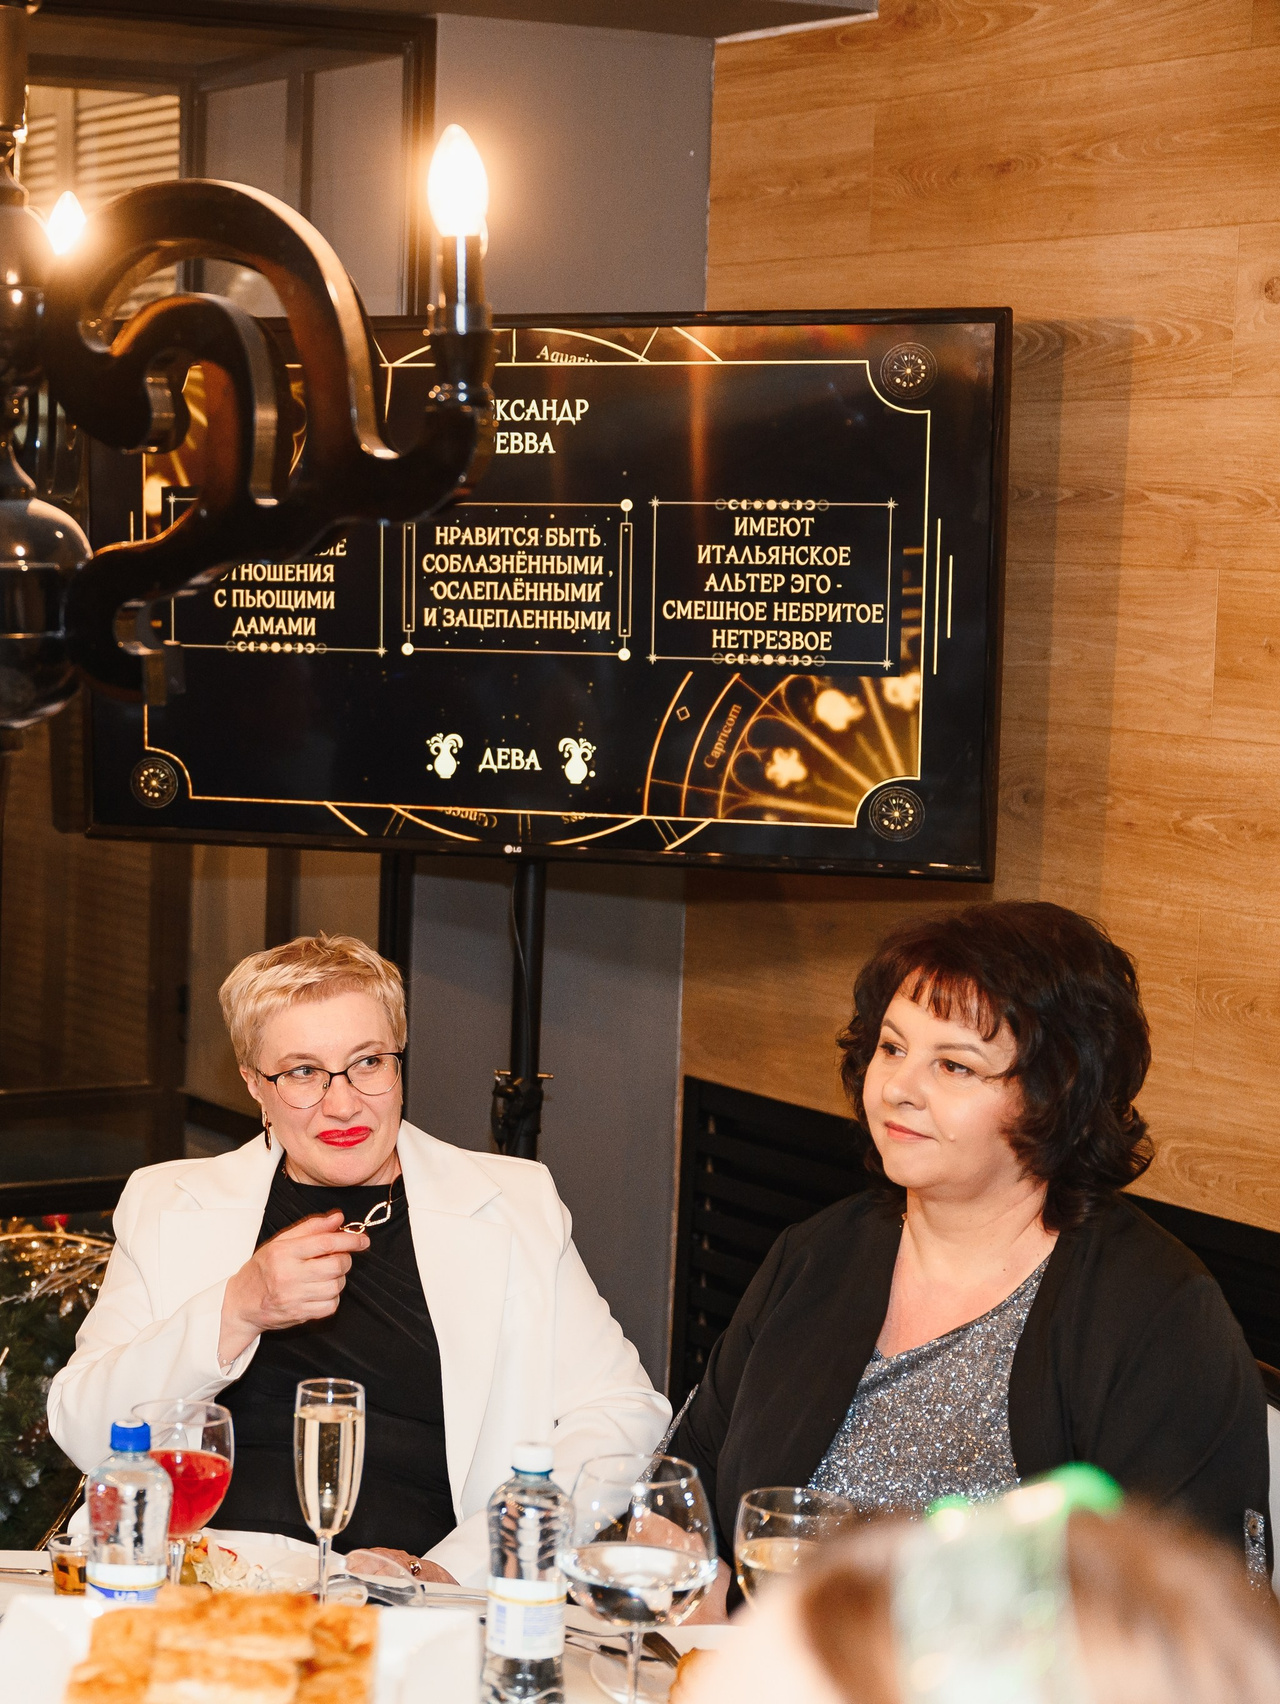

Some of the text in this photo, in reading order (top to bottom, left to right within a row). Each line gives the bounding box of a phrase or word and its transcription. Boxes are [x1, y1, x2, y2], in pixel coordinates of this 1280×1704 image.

[536, 345, 598, 363] Aquari
[491, 399, 589, 425] КСАНДР
[493, 432, 556, 454] ЕВВА
[435, 526, 601, 547] НРАВИТСЯ БЫТЬ
[734, 516, 815, 537] ИМЕЮТ
[422, 551, 604, 575] СОБЛАЗНЁННЫМИ
[697, 545, 851, 566] ИТАЛЬЯНСКОЕ
[220, 563, 335, 582] ТНОШЕНИЯ
[704, 573, 785, 593] АЛЬТЕР
[791, 574, 831, 594] ЭГО
[214, 588, 335, 611] С ПЬЮЩИМИ
[433, 577, 601, 602] ОСЛЕПЛЁННЫМИ
[423, 608, 611, 631] И ЗАЦЕПЛЕННЫМИ
[662, 600, 884, 624] СМЕШНОЕ НЕБРИТОЕ
[232, 616, 316, 637] ДАМАМИ
[712, 629, 832, 651] НЕТРЕЗВОЕ
[703, 704, 742, 768] Capricorn
[478, 747, 542, 774] ДЕВА
